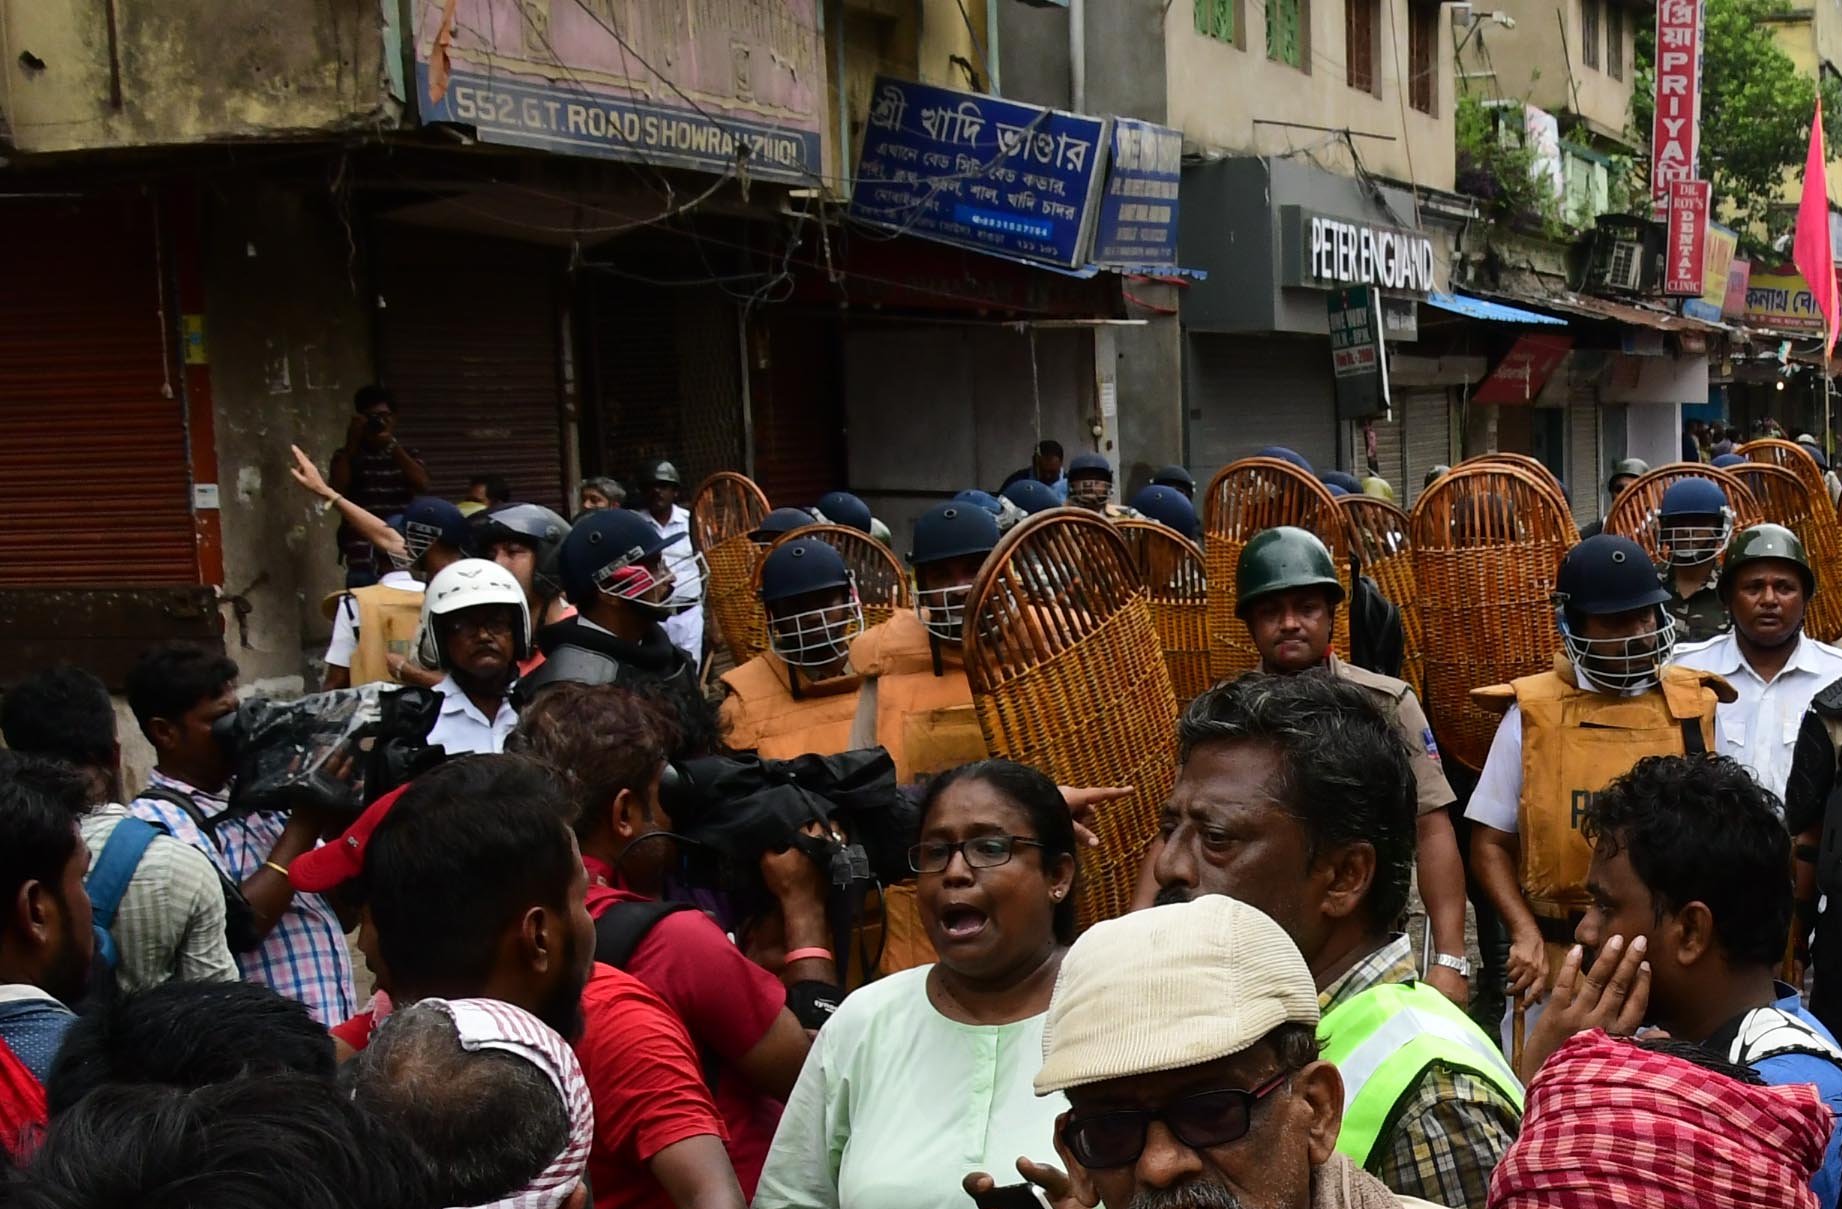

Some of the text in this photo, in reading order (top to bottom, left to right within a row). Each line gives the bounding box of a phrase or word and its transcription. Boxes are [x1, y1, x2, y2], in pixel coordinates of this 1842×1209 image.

[920, 101, 985, 149] খাদি
[1660, 52, 1689, 161] PRIYA
[1311, 216, 1434, 292] PETER ENGLAND
[1677, 211, 1695, 280] DENTAL
[1667, 280, 1700, 293] CLINIC
